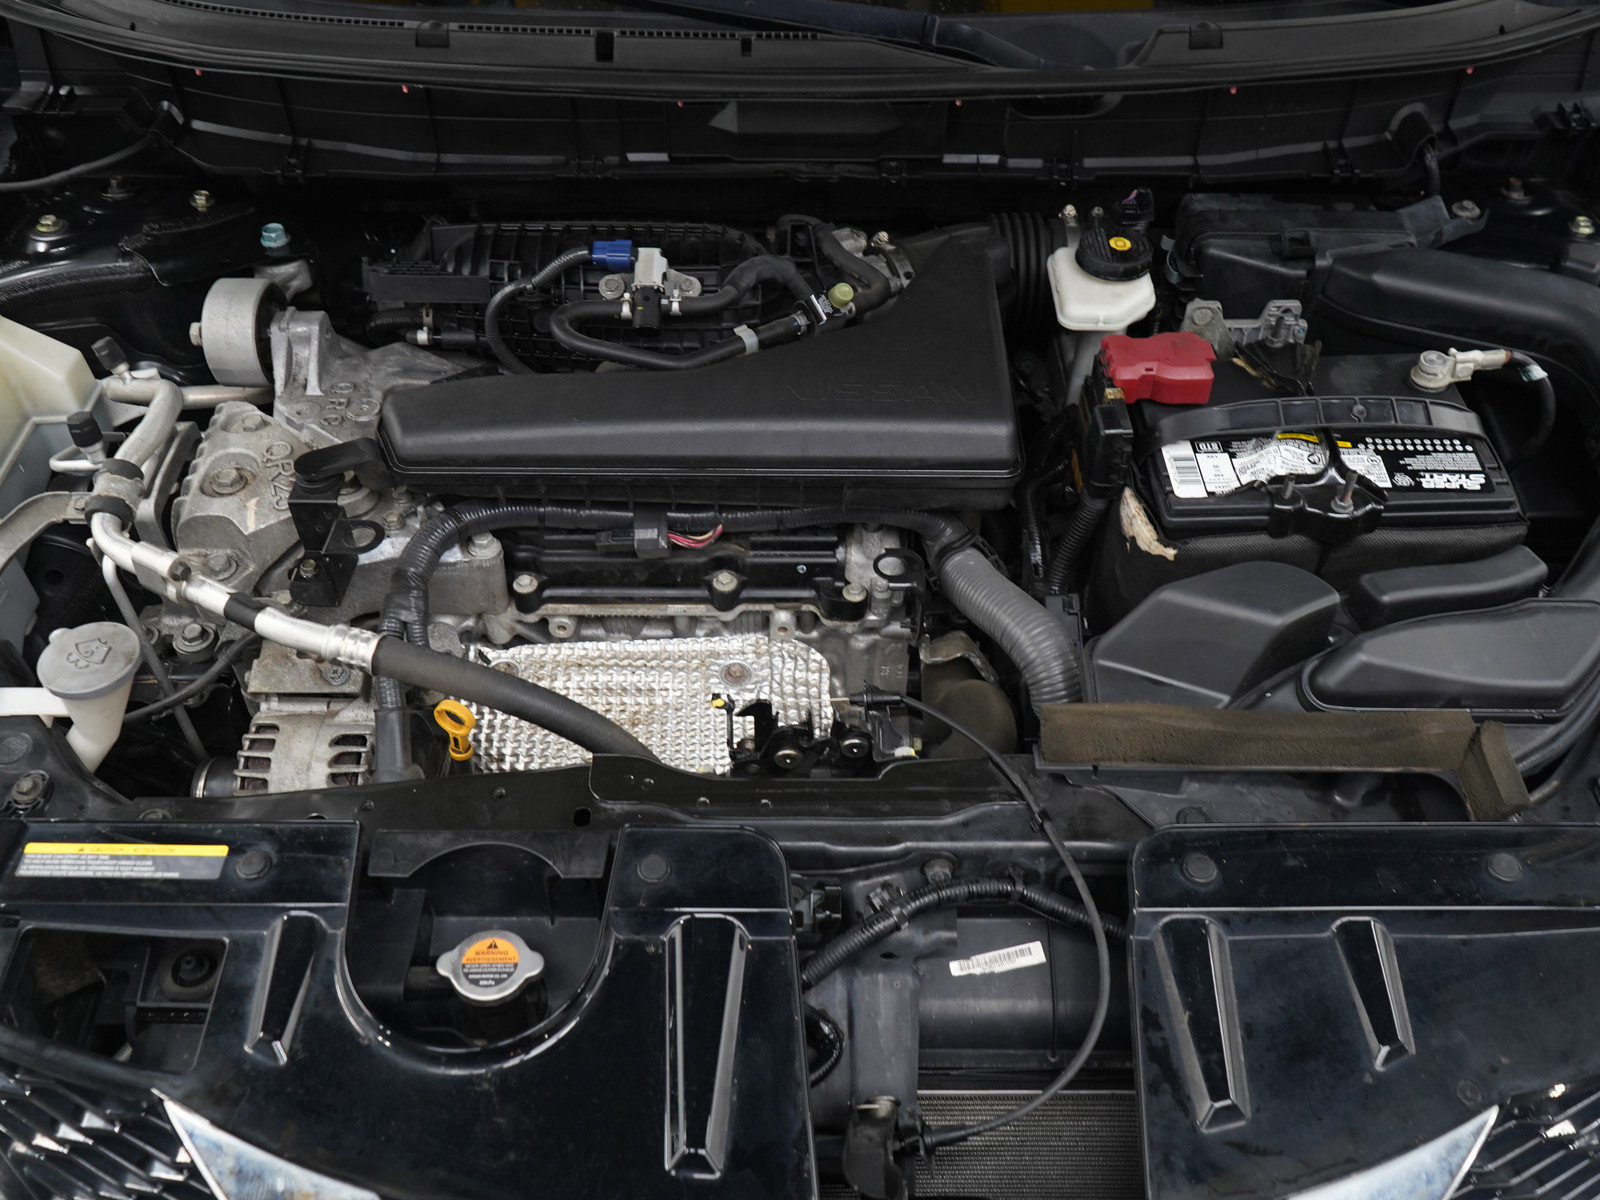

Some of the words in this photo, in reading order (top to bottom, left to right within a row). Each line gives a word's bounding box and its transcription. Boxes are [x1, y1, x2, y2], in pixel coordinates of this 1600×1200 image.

[778, 382, 979, 403] NISSAN
[1419, 473, 1486, 484] START
[1422, 479, 1482, 491] SUPER
